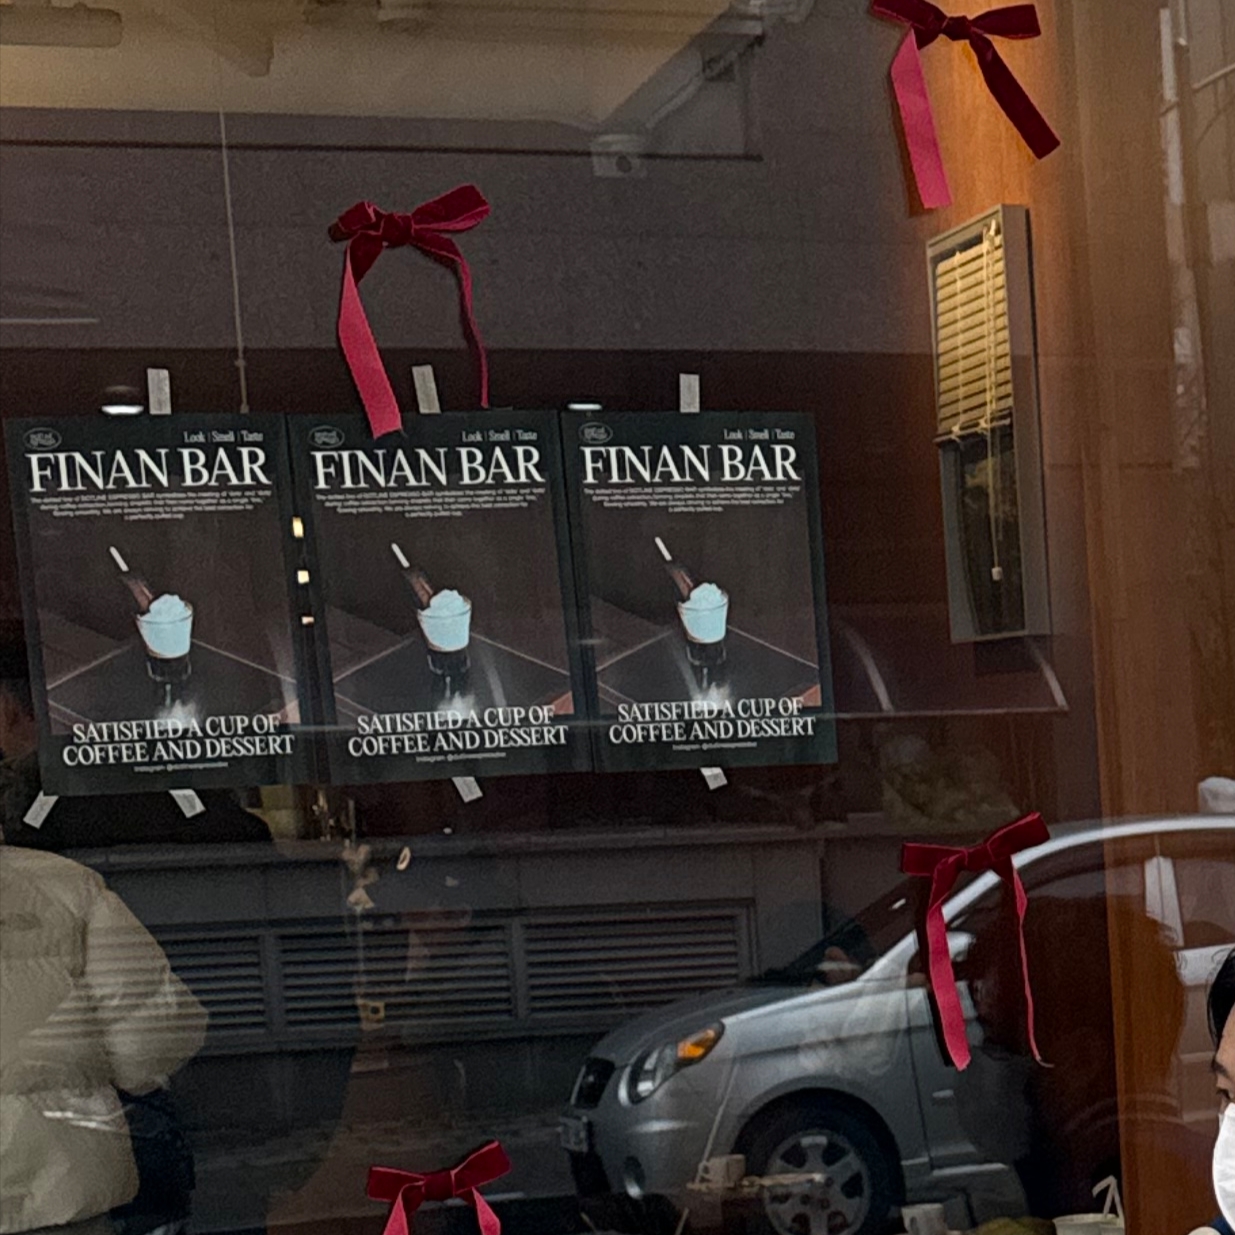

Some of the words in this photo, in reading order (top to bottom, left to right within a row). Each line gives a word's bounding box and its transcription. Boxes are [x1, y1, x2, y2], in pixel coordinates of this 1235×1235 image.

[25, 449, 169, 492] FINAN
[177, 447, 272, 487] BAR
[311, 448, 448, 489] FINAN
[455, 445, 546, 485] BAR
[579, 445, 711, 484] FINAN
[718, 444, 802, 482] BAR
[357, 710, 462, 735] SATISFIED
[467, 709, 482, 728] A
[483, 707, 525, 728] CUP
[528, 705, 556, 726] OF
[617, 700, 717, 723] SATISFIED
[721, 700, 735, 718] A
[737, 698, 776, 718] CUP
[778, 697, 804, 717] OF
[73, 718, 183, 744] SATISFIED
[188, 718, 204, 737] A
[205, 715, 249, 738] CUP
[252, 713, 282, 735] OF
[348, 734, 430, 757] COFFEE
[433, 731, 480, 752] AND
[484, 725, 569, 749] DESSERT
[609, 722, 687, 744] COFFEE
[689, 720, 733, 742] AND
[737, 717, 816, 739] DESSERT
[63, 742, 149, 766] COFFEE
[152, 739, 202, 763] AND
[205, 735, 295, 759] DESSERT
